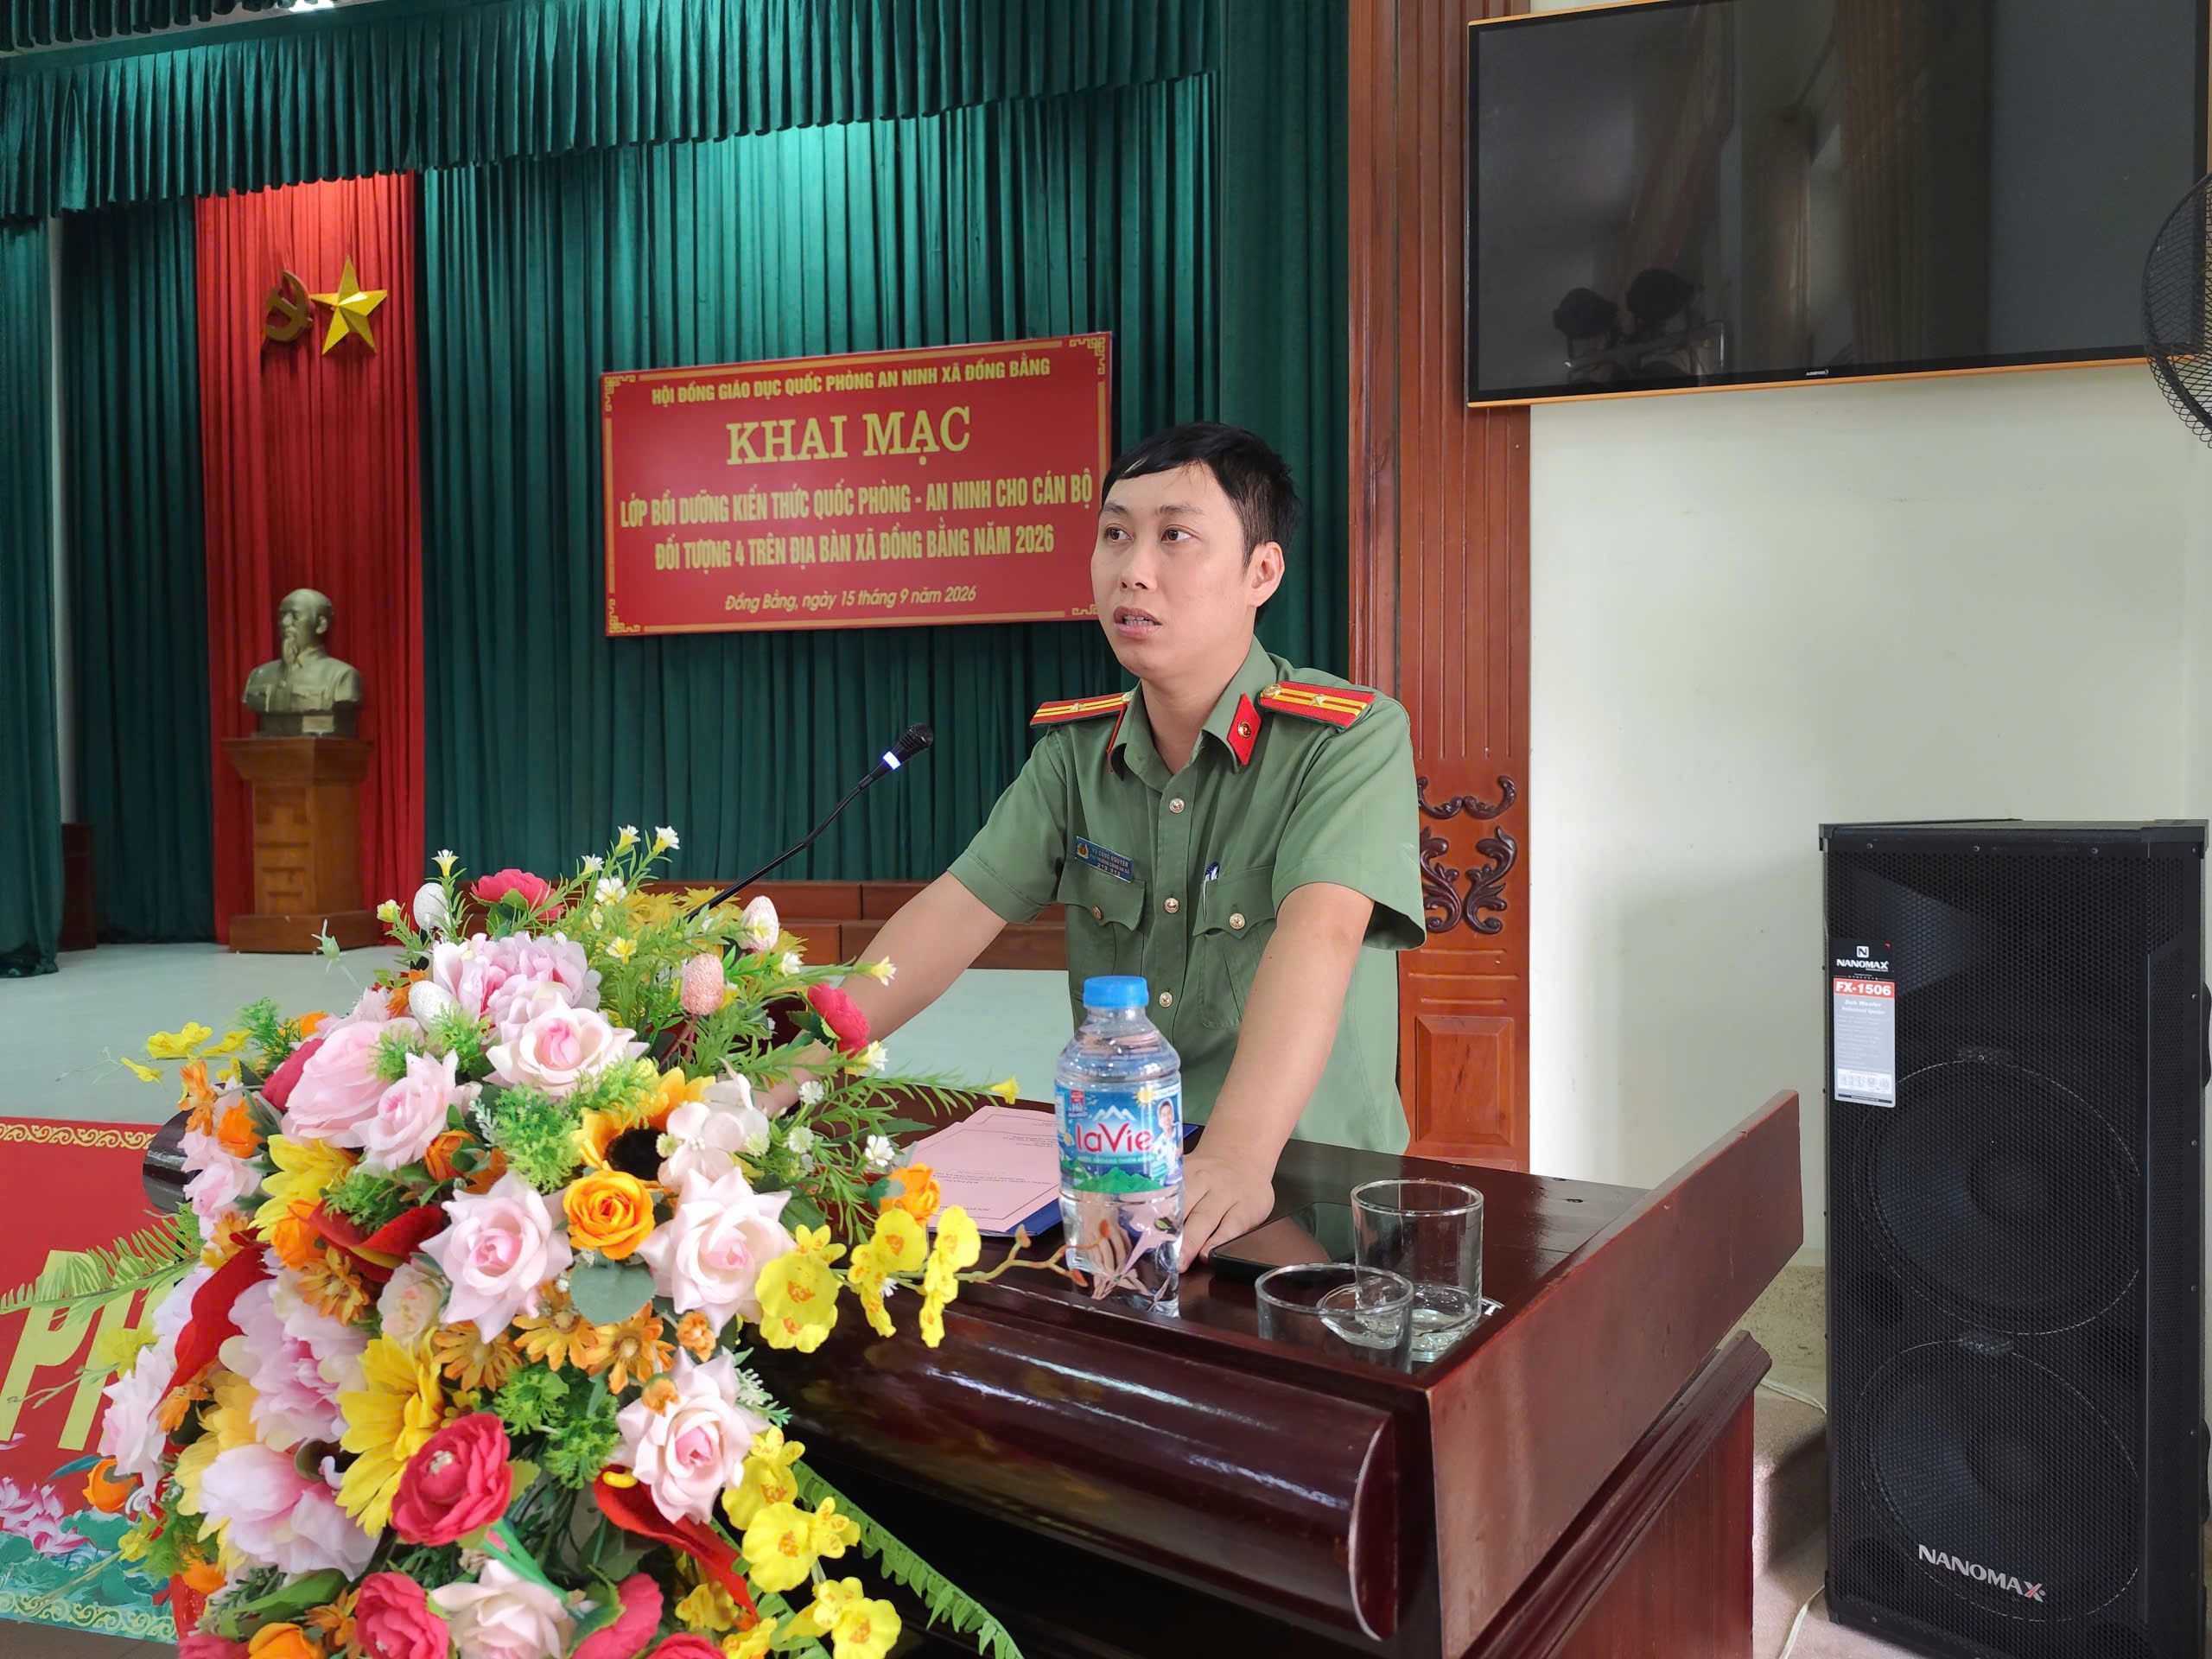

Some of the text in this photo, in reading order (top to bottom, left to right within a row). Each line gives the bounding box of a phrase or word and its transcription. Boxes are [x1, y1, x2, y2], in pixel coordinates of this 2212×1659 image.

[652, 385, 675, 408] HỘI
[718, 379, 751, 400] GIÁO
[753, 379, 782, 400] DỤC
[785, 372, 823, 397] QUỐC
[826, 370, 874, 392] PHÒNG
[878, 370, 899, 388] AN
[902, 367, 938, 386] NINH
[942, 362, 962, 383] XÃ
[726, 406, 970, 466] KHAI MẠC
[620, 492, 647, 528] LỚP
[679, 489, 729, 524] DƯỠNG
[733, 484, 768, 522] KIẾN
[771, 483, 810, 519] THỨC
[814, 478, 854, 520] QUỐC
[858, 479, 911, 515] PHÒNG
[925, 483, 948, 512] AN
[952, 480, 992, 510] NINH
[996, 477, 1028, 507] CHO
[1033, 470, 1066, 505] CÁN
[1071, 467, 1093, 509] BỘ
[683, 539, 732, 574] TƯỢNG
[735, 540, 745, 566] 4
[747, 531, 786, 566] TRÊN
[790, 536, 817, 570] ĐỊA
[819, 528, 851, 563] BÀN
[855, 527, 876, 561] XÃ
[926, 517, 969, 557] BẰNG
[974, 521, 1011, 556] NĂM
[1015, 524, 1054, 554] 2026
[802, 590, 837, 611] ngày
[842, 591, 855, 607] 15
[858, 588, 897, 608] tháng
[899, 588, 909, 603] 9
[910, 587, 942, 603] năm
[945, 586, 977, 602] 2026
[1836, 959, 1889, 969] NANOMAX
[1835, 982, 1891, 996] FX-1506
[1076, 1122, 1154, 1154] laVie
[1918, 1543, 2044, 1603] NANOMAX
